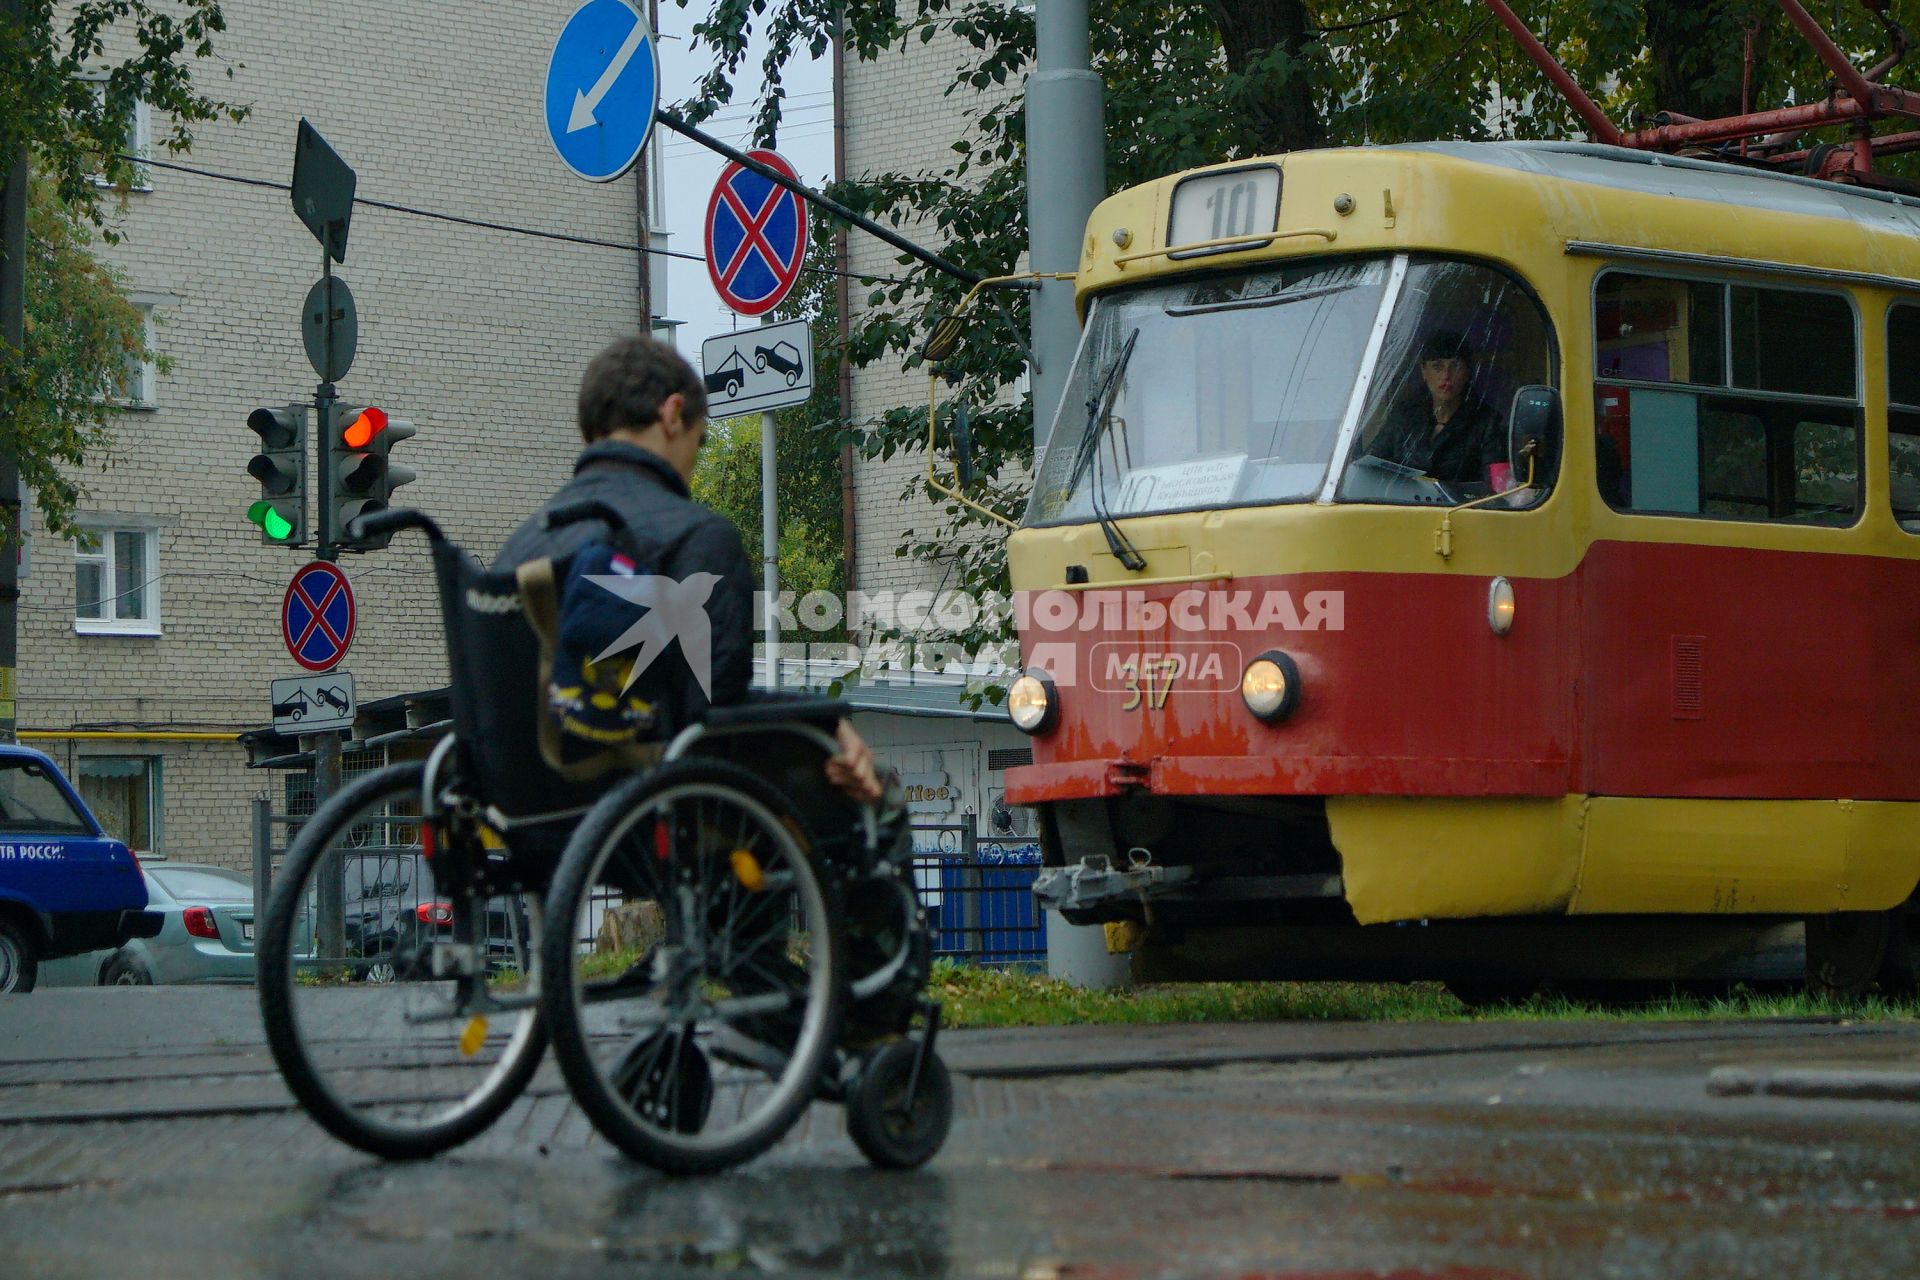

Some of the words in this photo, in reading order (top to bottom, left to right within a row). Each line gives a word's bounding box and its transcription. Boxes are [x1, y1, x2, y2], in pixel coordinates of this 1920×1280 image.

[1207, 181, 1257, 239] 10
[1122, 660, 1179, 711] 317
[905, 784, 949, 802] ffee
[0, 845, 16, 859] ТА
